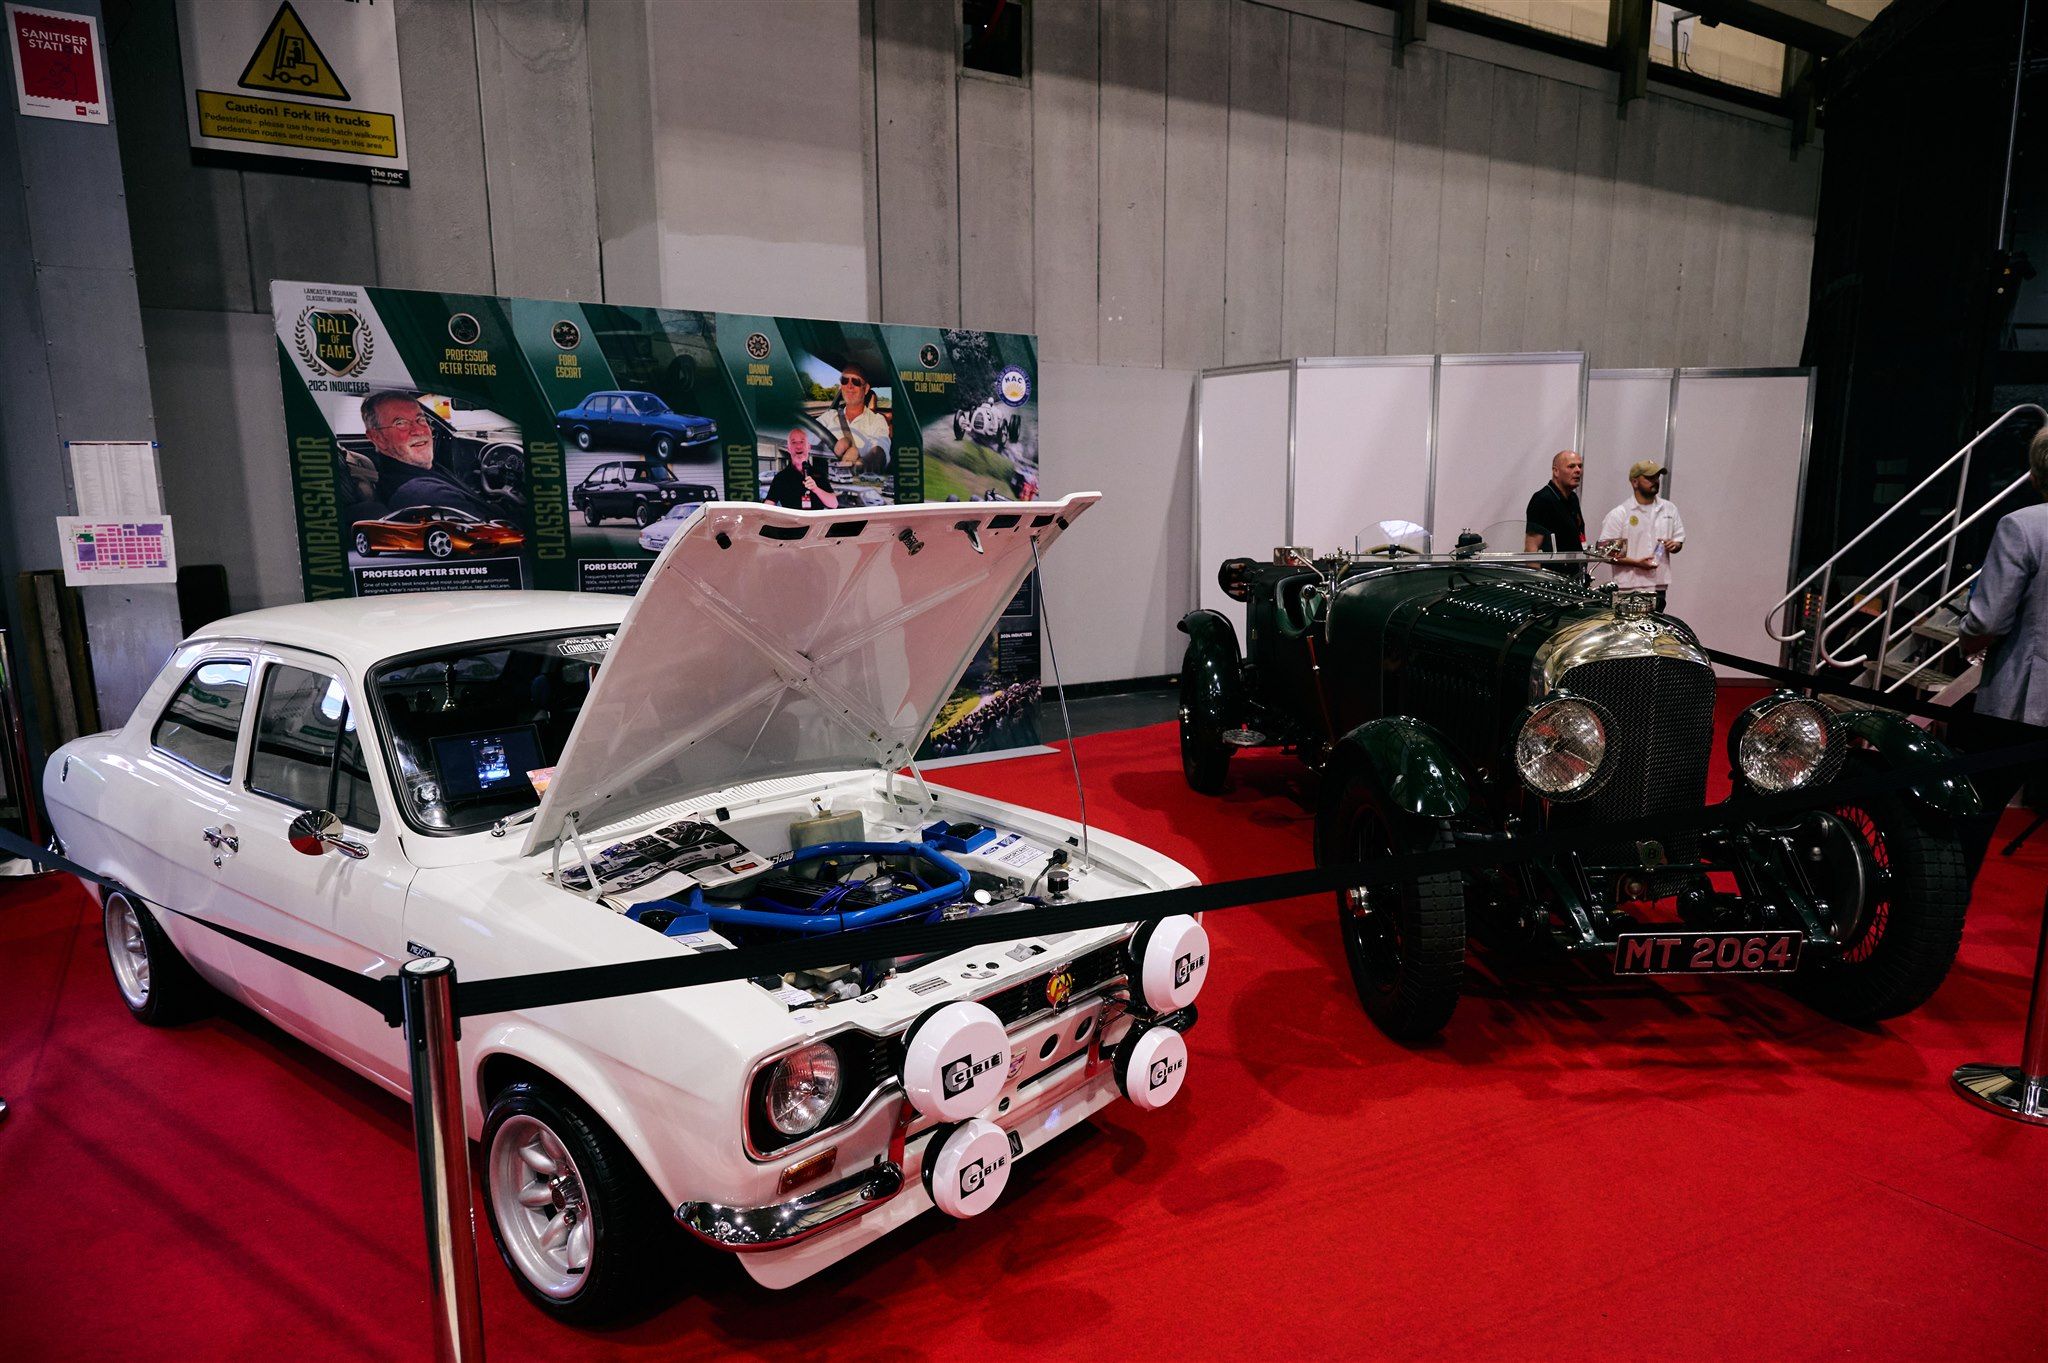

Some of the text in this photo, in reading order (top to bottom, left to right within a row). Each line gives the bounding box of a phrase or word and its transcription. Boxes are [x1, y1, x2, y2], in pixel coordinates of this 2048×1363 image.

[21, 28, 88, 46] SANITISER
[225, 101, 371, 128] Caution! Fork lift trucks
[204, 112, 252, 124] Pedestrians
[259, 119, 284, 130] please
[302, 124, 315, 132] the
[331, 128, 352, 136] hatch
[216, 125, 259, 136] pedestrian
[262, 130, 286, 138] routes
[305, 135, 341, 145] crossings
[371, 168, 385, 177] the
[304, 288, 330, 296] LANCASTER
[316, 318, 350, 335] HALL
[330, 335, 340, 343] OF
[320, 344, 352, 359] FAME
[445, 348, 488, 362] PROFESSOR
[559, 354, 577, 366] FORD
[440, 363, 496, 376] PETER STEVENS
[556, 366, 582, 378] ESCORT
[748, 363, 770, 374] DANNY
[746, 374, 773, 386] HOPKINS
[900, 371, 956, 383] MIDLAND AUTOMOBILE
[308, 380, 370, 392] 2025 INDUCTEES
[915, 382, 927, 392] CLUB
[898, 447, 920, 487] CLUB
[530, 441, 566, 560] CLASSIC CAR
[296, 436, 343, 578] AMBASSADOR
[362, 567, 488, 578] PROFESSOR PETER STEVENS
[563, 642, 597, 653] LONDON
[1624, 936, 1791, 970] MT 2064
